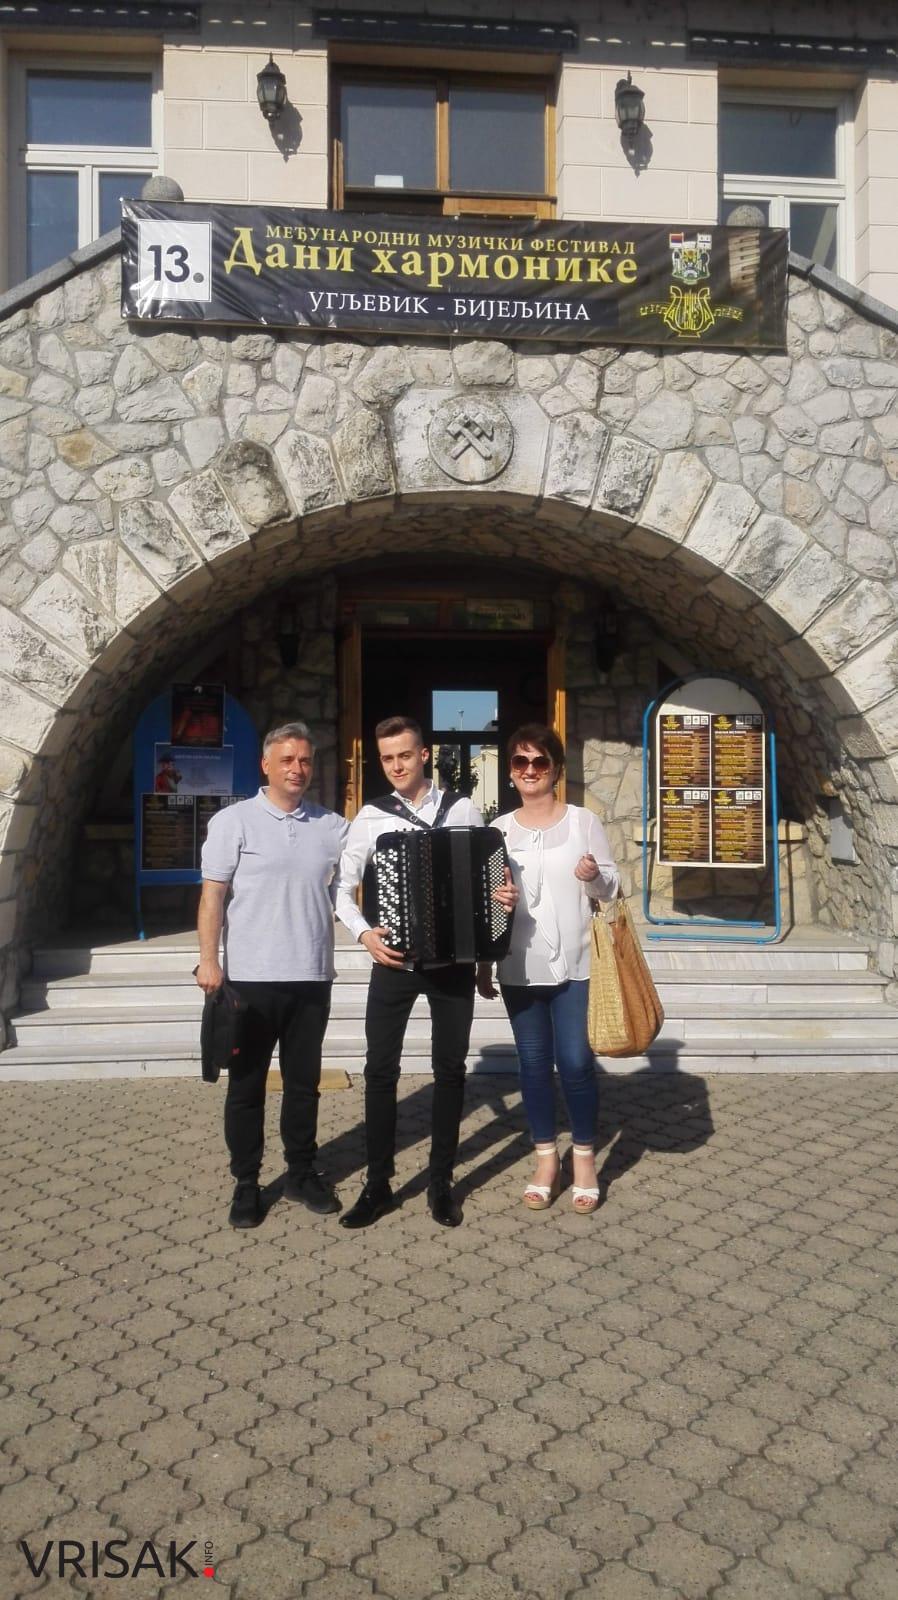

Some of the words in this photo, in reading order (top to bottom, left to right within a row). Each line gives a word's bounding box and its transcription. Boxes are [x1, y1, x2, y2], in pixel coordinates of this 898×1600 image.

[266, 225, 420, 246] МЕЂУНАРОДНИ
[428, 233, 524, 251] МУЗИЧКИ
[530, 238, 636, 255] ФЕСТИВАЛ
[147, 245, 205, 284] 13.
[224, 228, 355, 276] Дани
[372, 248, 638, 288] хармонике
[308, 290, 430, 315] УГЉЕВИК
[453, 298, 591, 321] БИЈЕЉИНА
